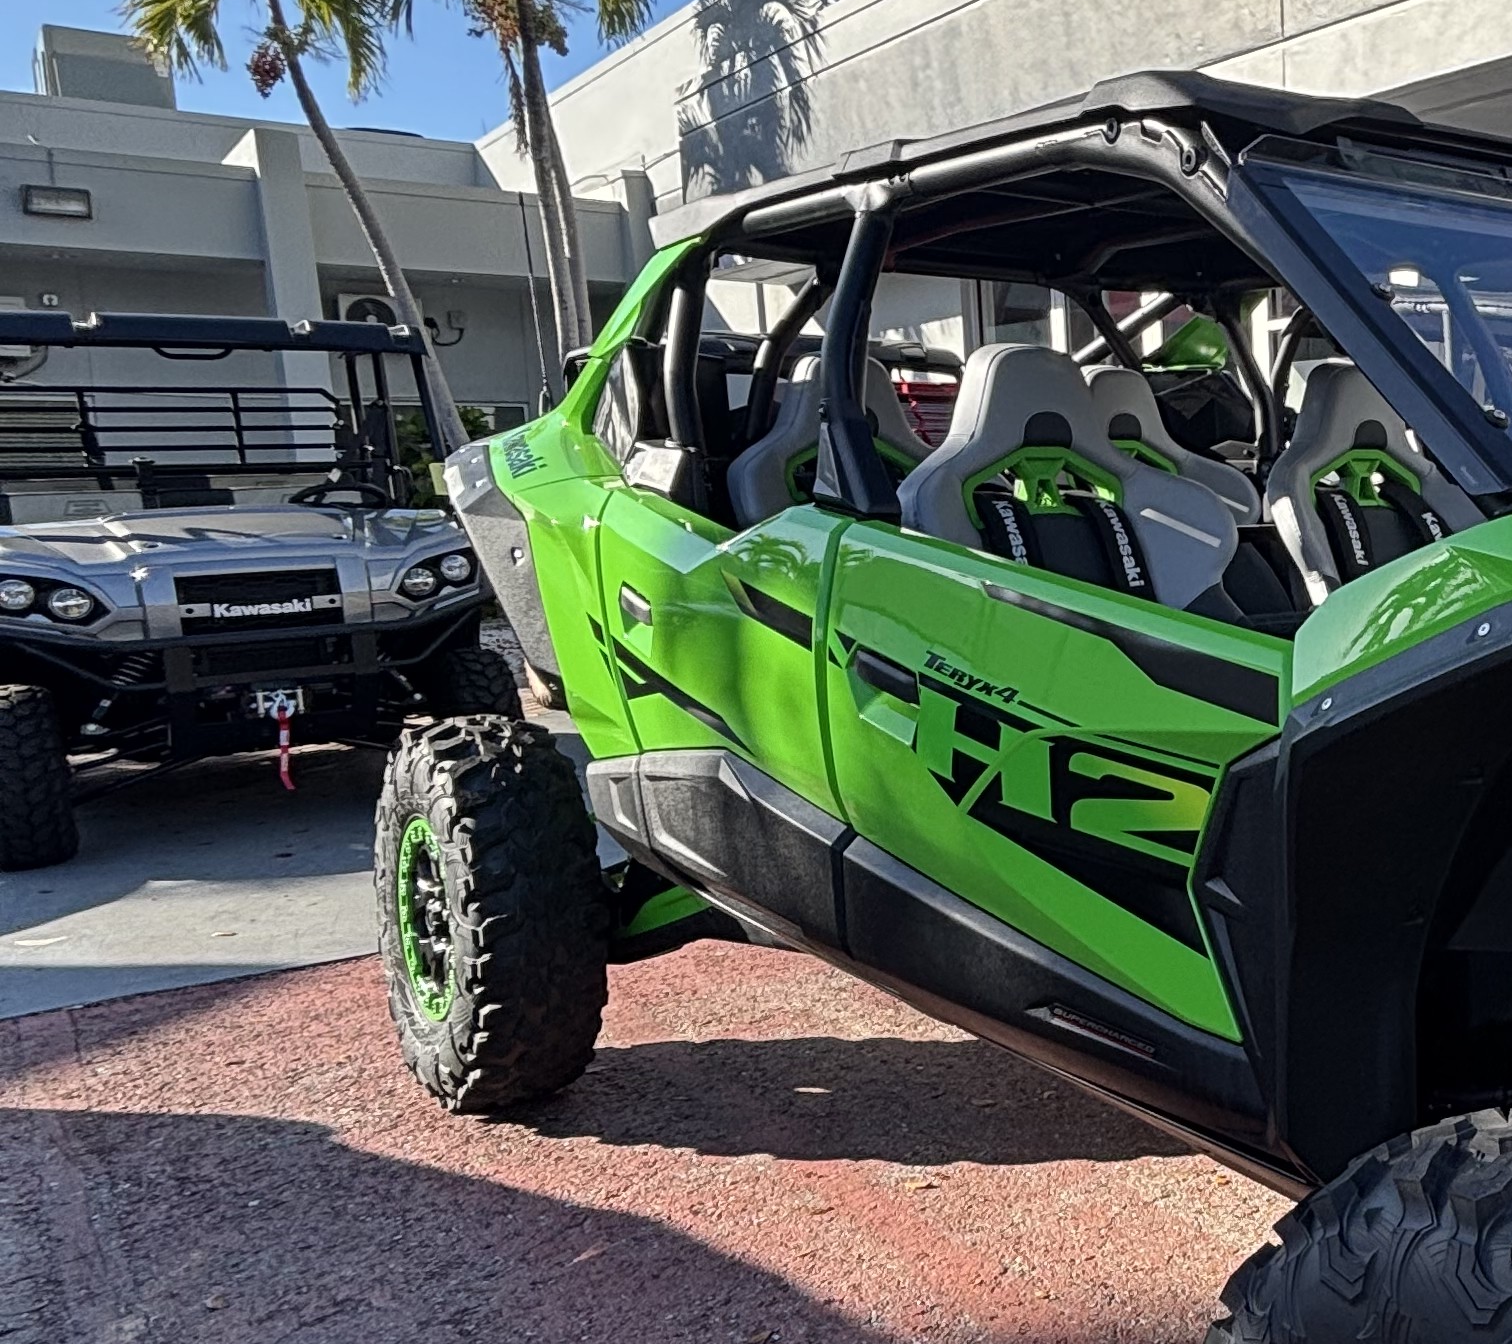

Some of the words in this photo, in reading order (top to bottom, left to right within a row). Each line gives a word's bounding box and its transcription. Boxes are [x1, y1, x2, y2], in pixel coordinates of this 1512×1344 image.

[1095, 499, 1146, 588] Kawasaki
[1330, 492, 1369, 567] Kawasaki
[213, 597, 313, 618] Kawasaki
[914, 683, 1212, 869] H2
[1052, 1006, 1156, 1055] SUPERCHARGED
